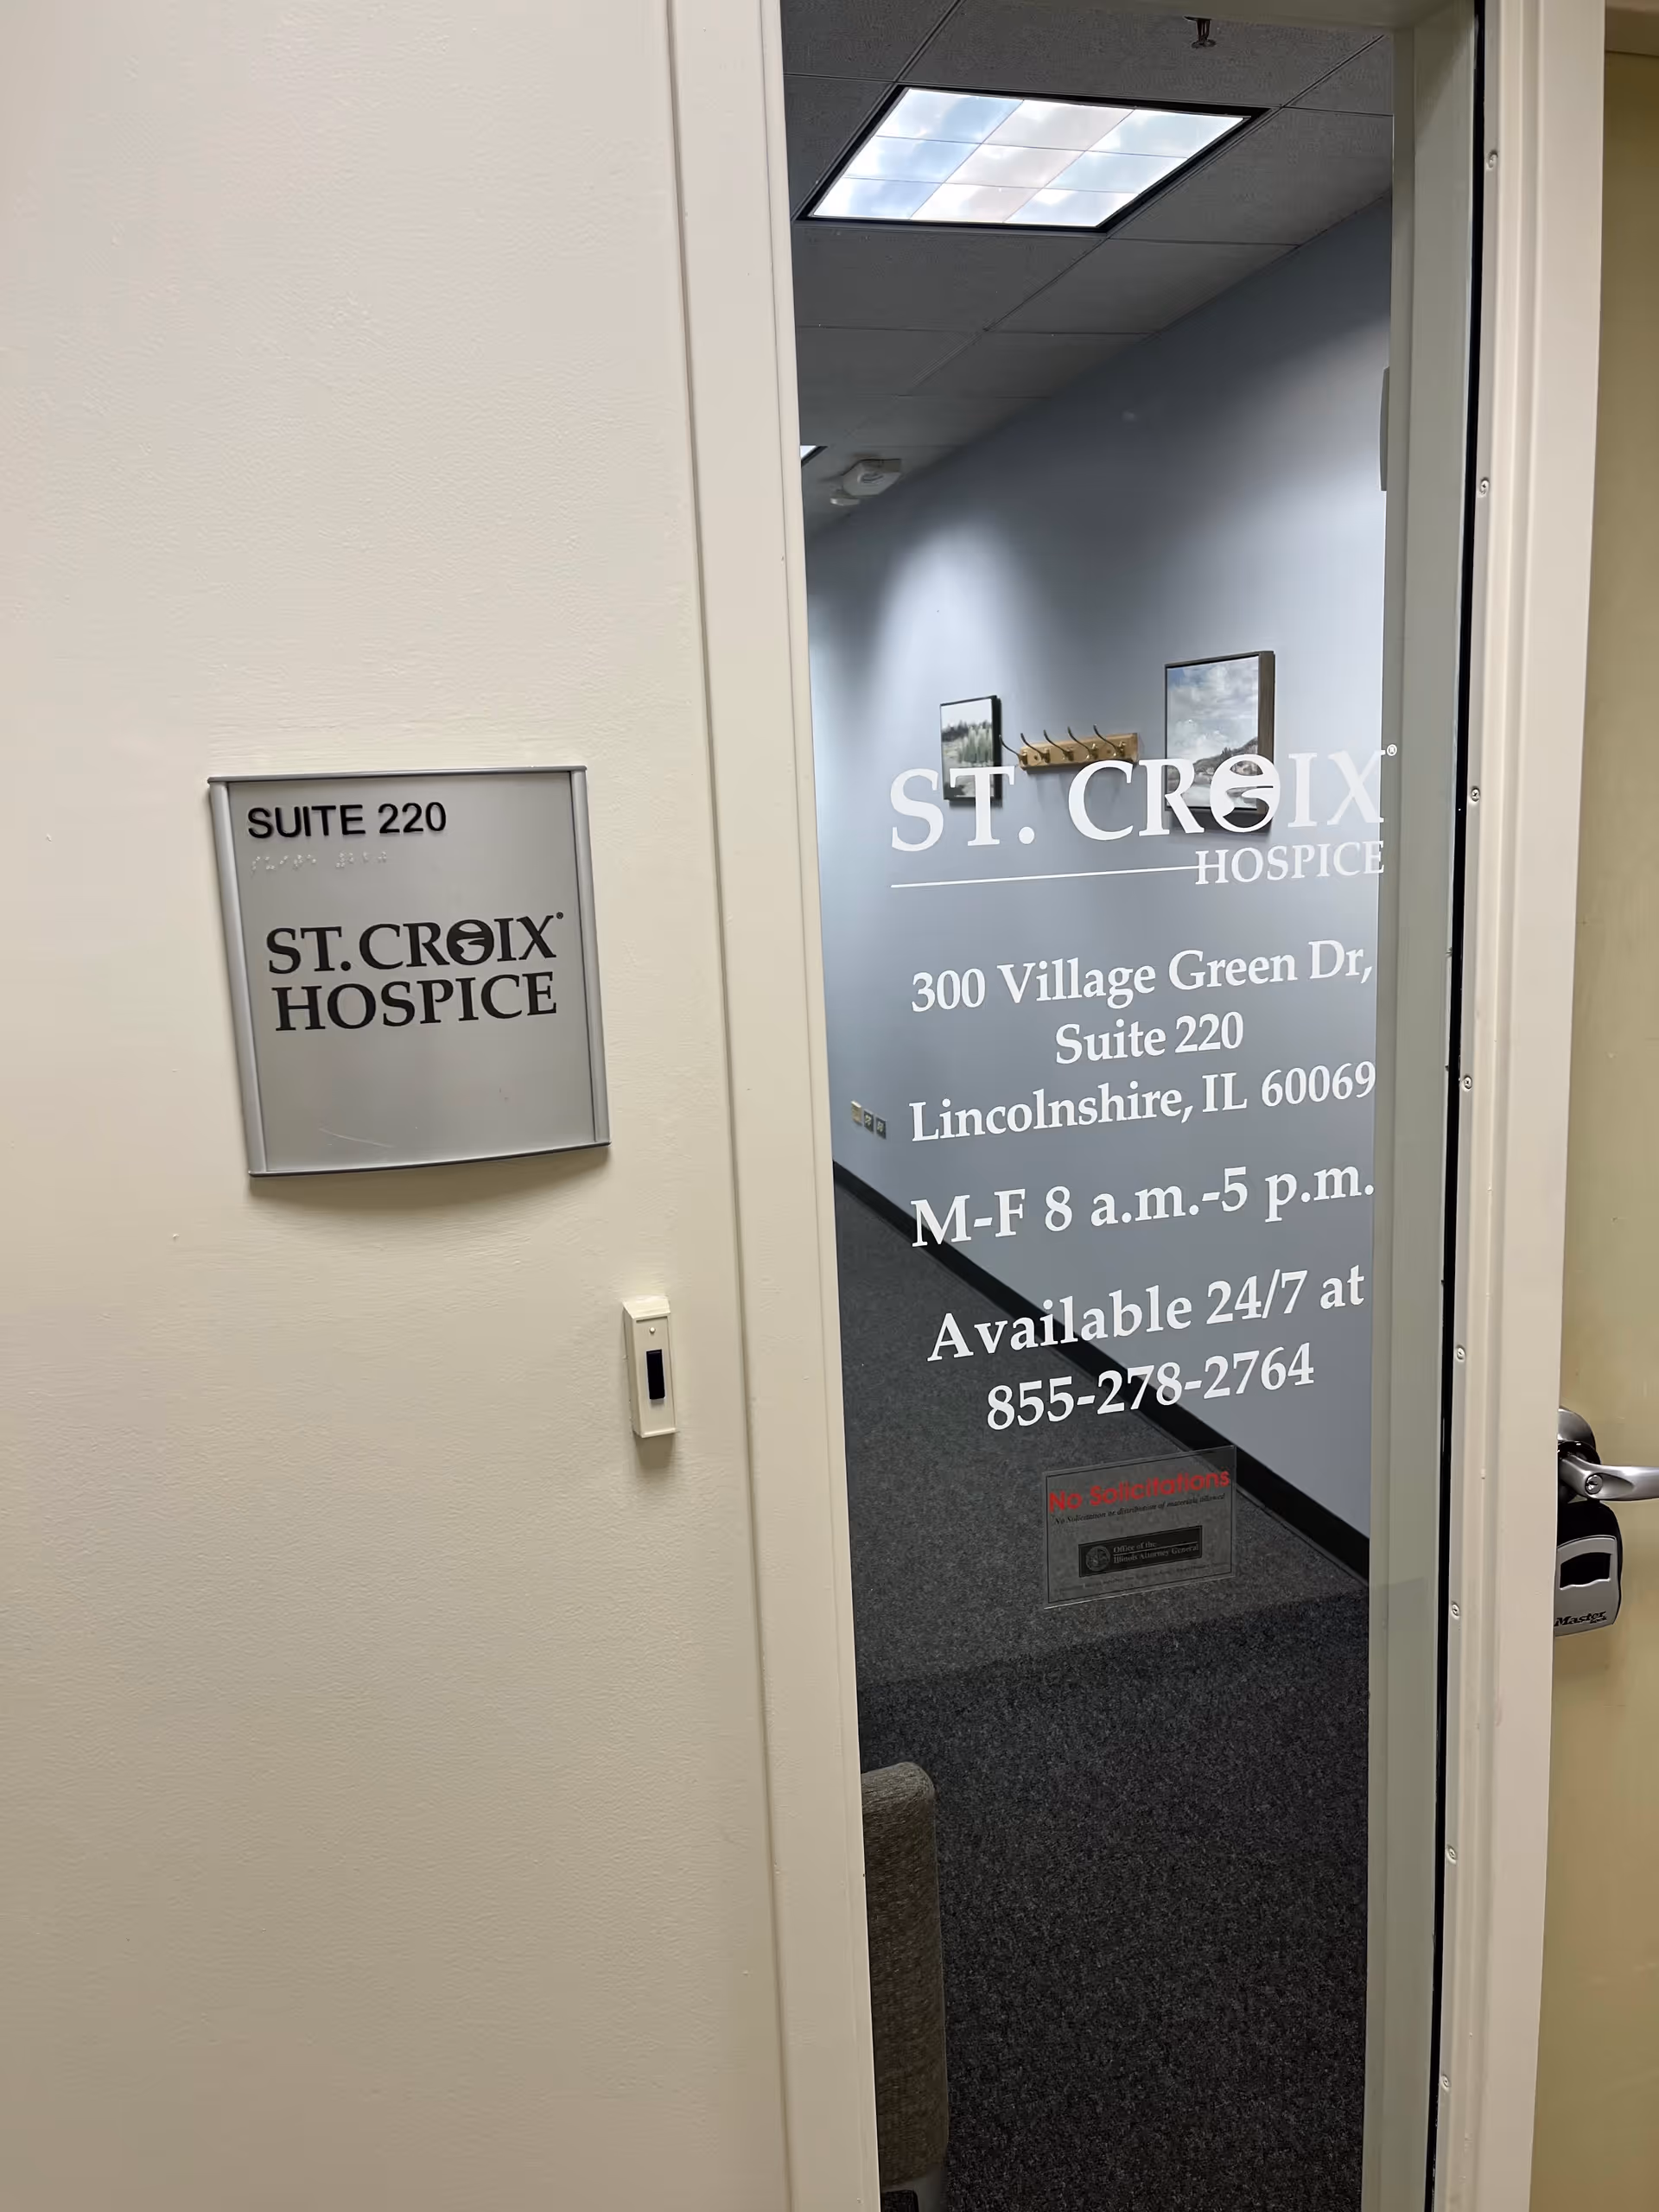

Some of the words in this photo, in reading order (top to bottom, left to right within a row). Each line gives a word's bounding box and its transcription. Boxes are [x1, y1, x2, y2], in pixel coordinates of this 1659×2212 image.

[247, 804, 365, 838] SUITE
[378, 802, 447, 834] 220
[890, 766, 1035, 852] ST.
[1195, 841, 1384, 885] HOSPICE
[271, 972, 557, 1032] HOSPICE
[911, 968, 985, 1012] 300
[997, 956, 1156, 1009] Village
[1168, 949, 1298, 991] Green
[1308, 939, 1373, 984] Dr,
[1055, 1018, 1166, 1065] Suite
[1175, 1011, 1244, 1053] 220
[909, 1080, 1193, 1141] Lincolnshire,
[1202, 1071, 1248, 1113] IL
[1261, 1060, 1376, 1108] 60069
[911, 1188, 1026, 1247] M-F
[1044, 1185, 1073, 1232] 8
[1090, 1166, 1249, 1225] a.m.-5
[1264, 1162, 1376, 1223] p.m.
[927, 1285, 1193, 1362] Available
[1206, 1268, 1308, 1325] 24/7
[1319, 1264, 1365, 1310] at
[987, 1342, 1314, 1431] 855-278-2764
[1049, 1491, 1083, 1512] No
[1090, 1470, 1230, 1507] Solicitations
[1113, 1544, 1135, 1554] Office
[1113, 1554, 1138, 1564] Illinois
[1139, 1549, 1170, 1560] Attorney
[1171, 1544, 1199, 1555] General
[1554, 1611, 1606, 1627] Master
